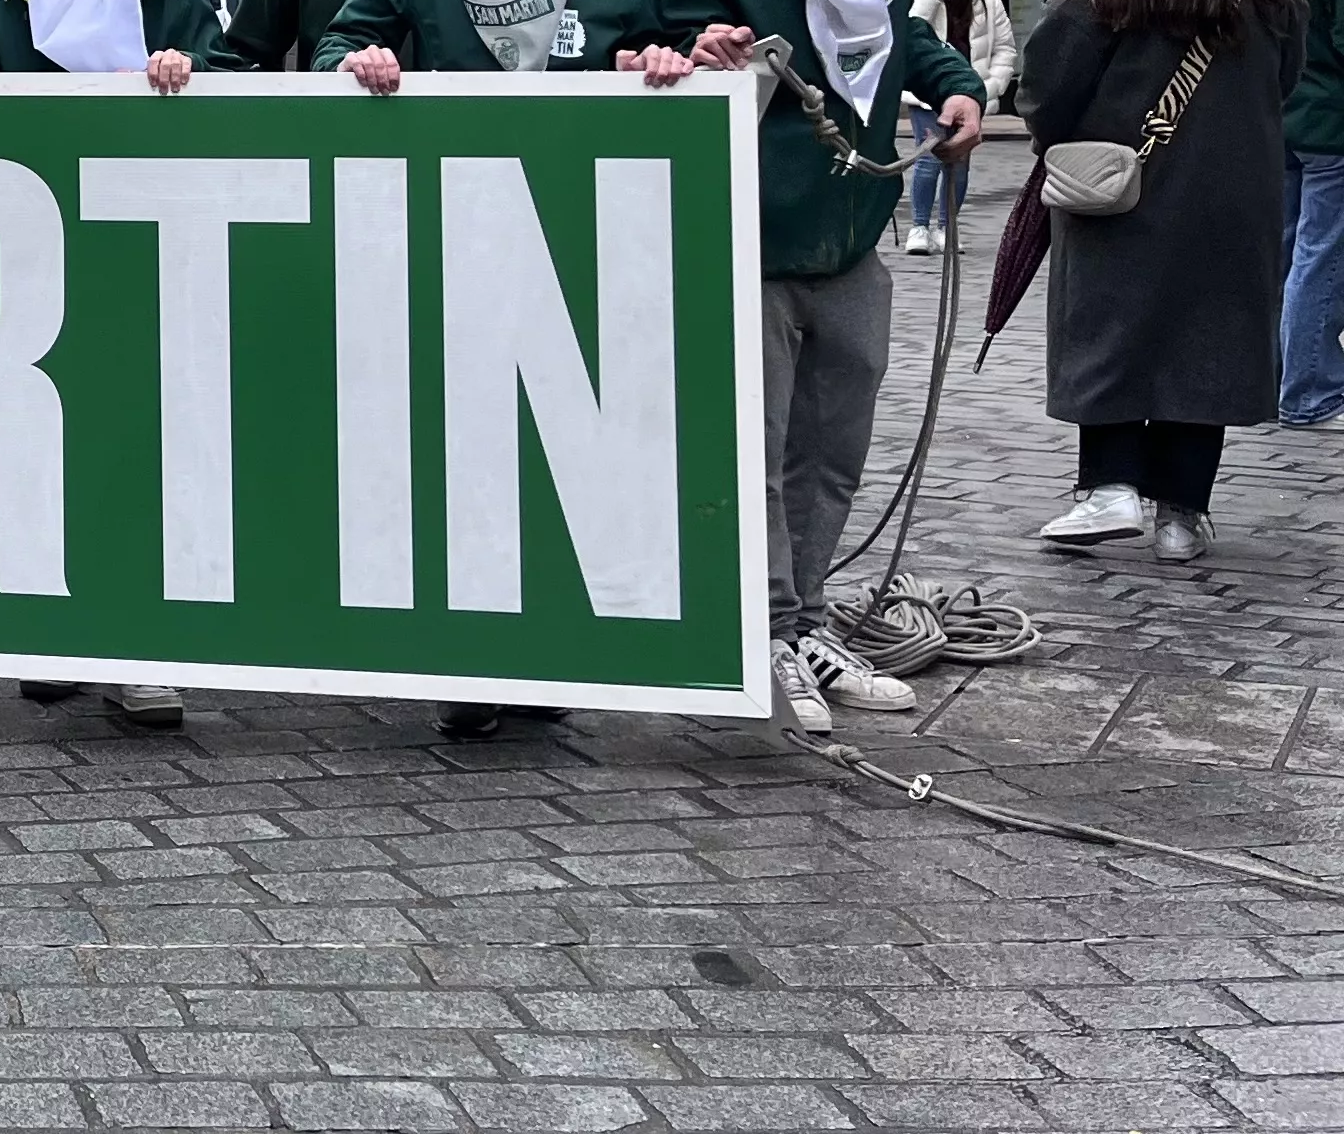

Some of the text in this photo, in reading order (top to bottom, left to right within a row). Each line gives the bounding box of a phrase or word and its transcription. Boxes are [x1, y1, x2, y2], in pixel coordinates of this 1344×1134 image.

[475, 5, 500, 25] SAN
[558, 19, 576, 31] SAN
[557, 41, 574, 54] TIN
